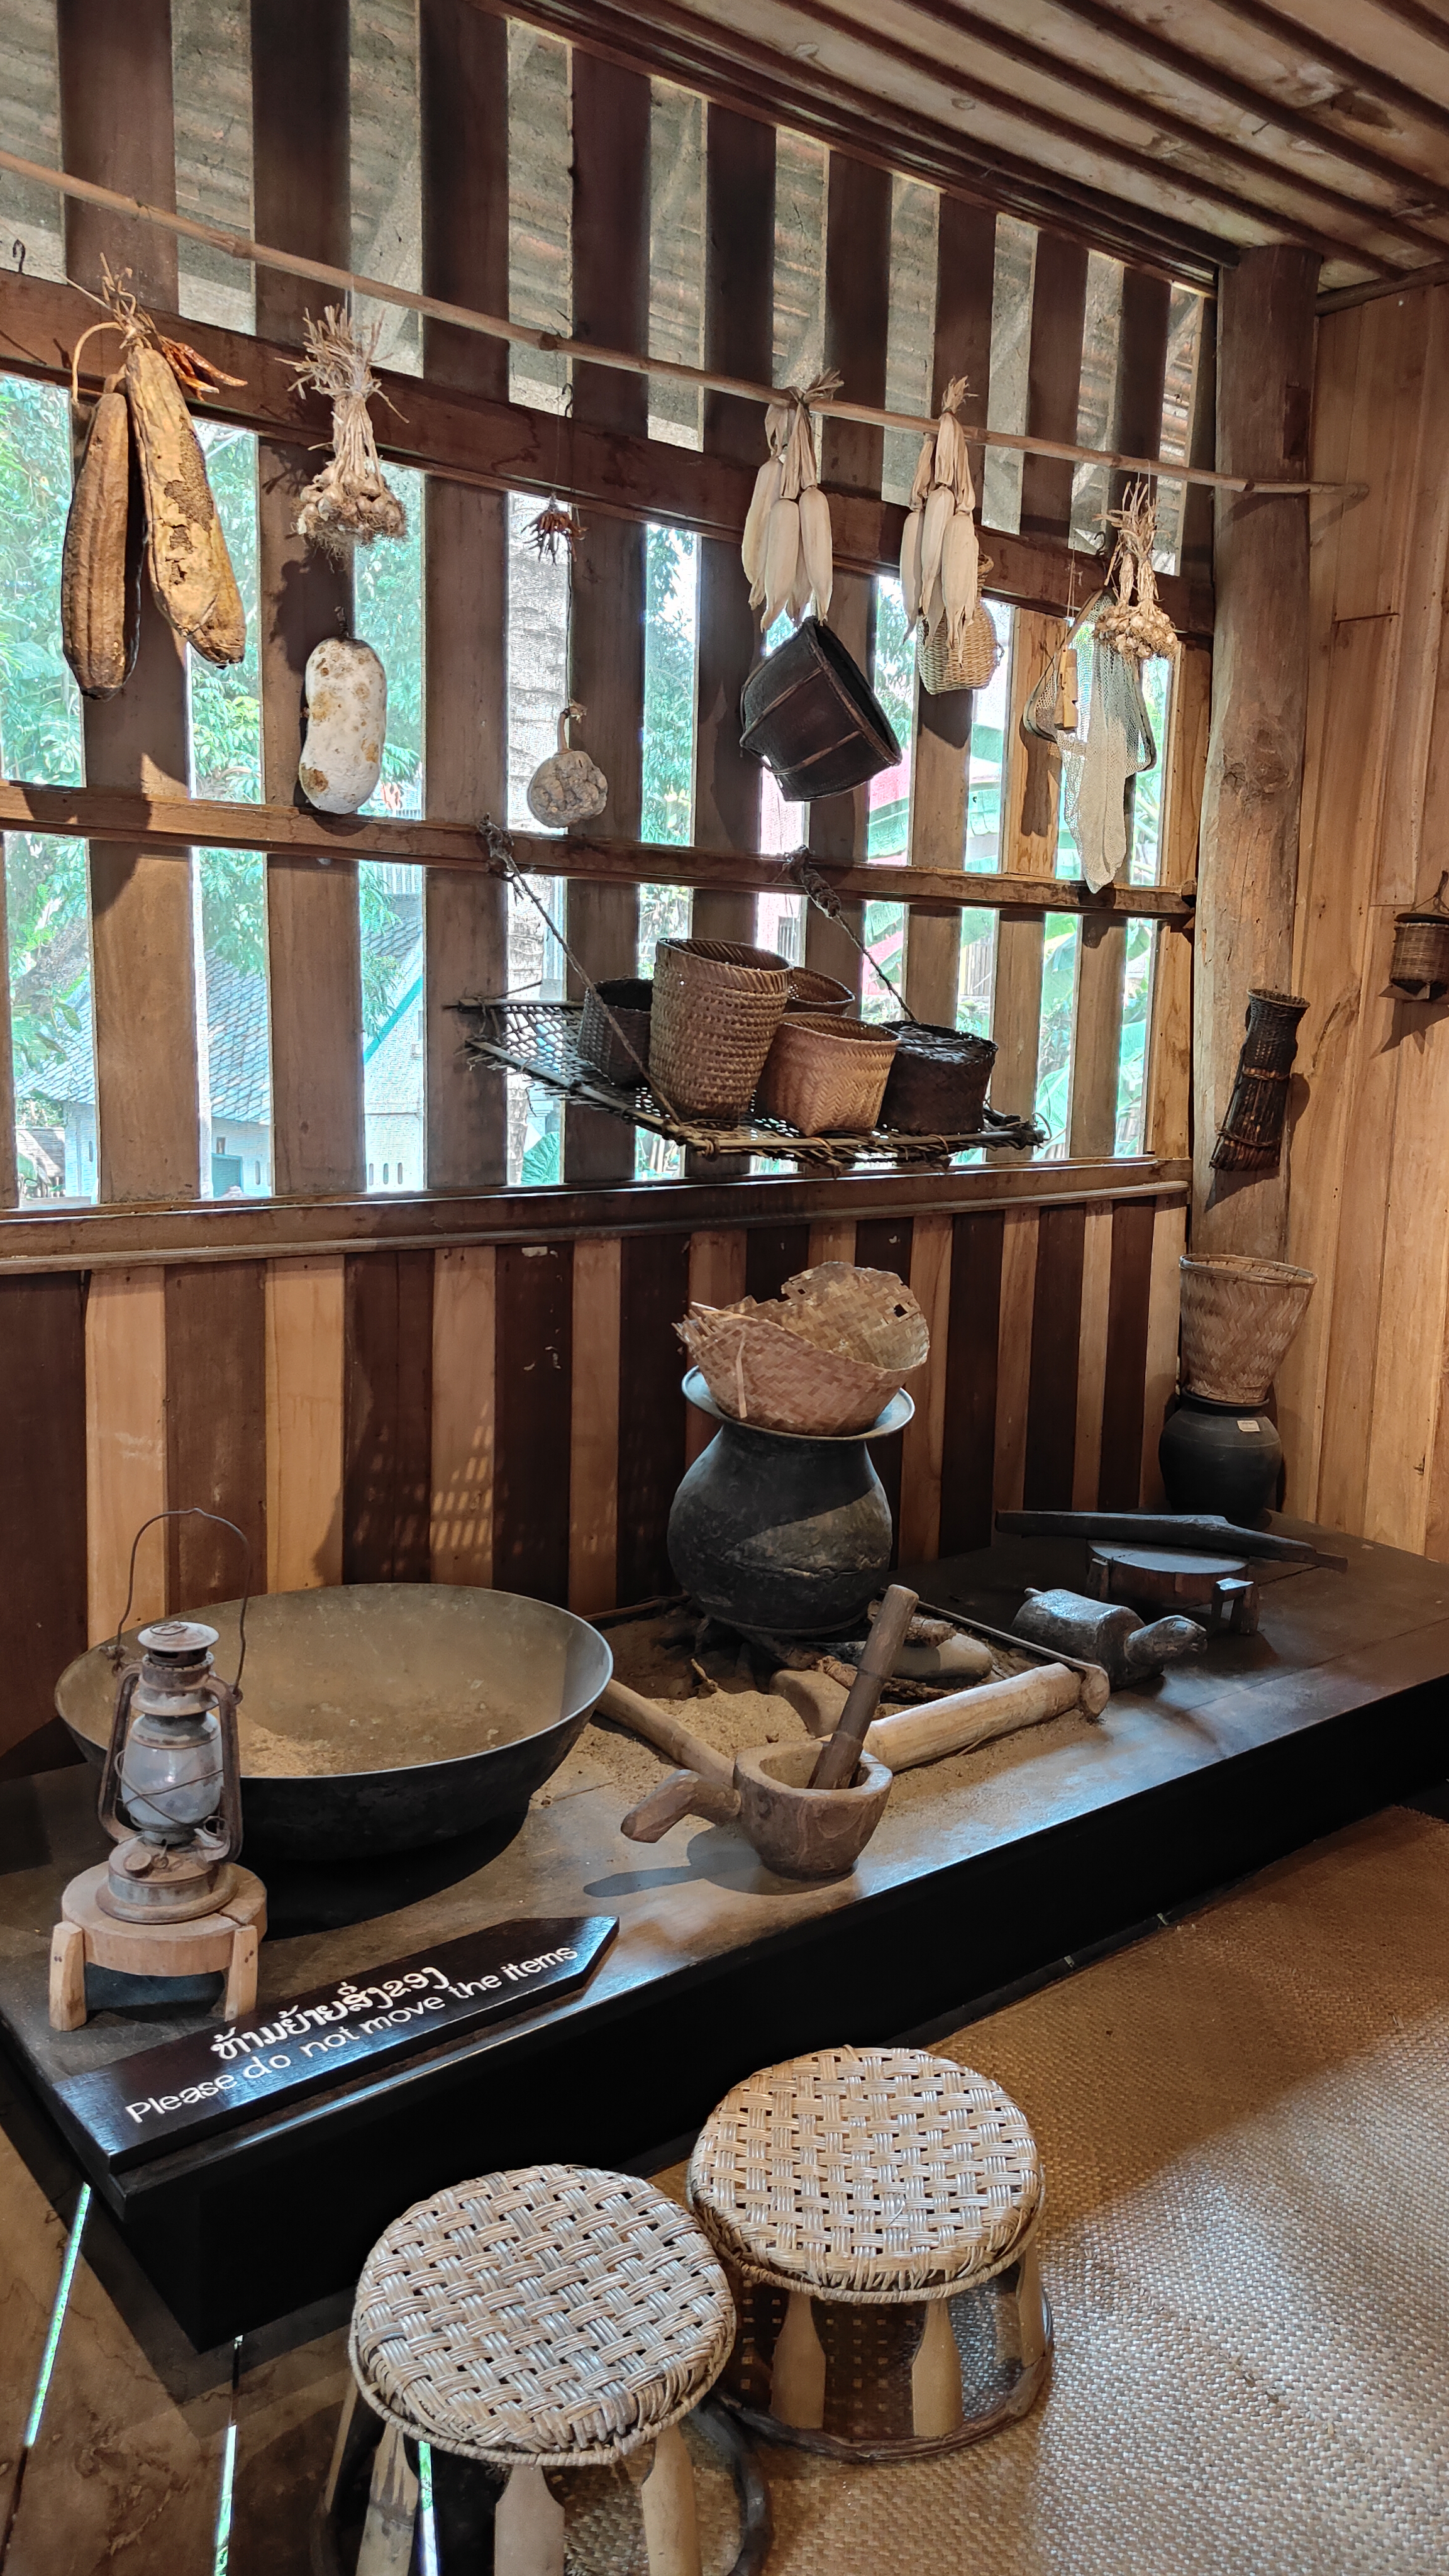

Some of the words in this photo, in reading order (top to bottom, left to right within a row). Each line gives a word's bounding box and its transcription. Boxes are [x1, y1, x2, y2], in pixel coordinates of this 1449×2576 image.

[125, 2075, 237, 2123] Please
[243, 2055, 291, 2079] do
[299, 2026, 360, 2057] not
[358, 1996, 446, 2035] move
[448, 1975, 502, 1999] the
[501, 1946, 578, 1981] items
